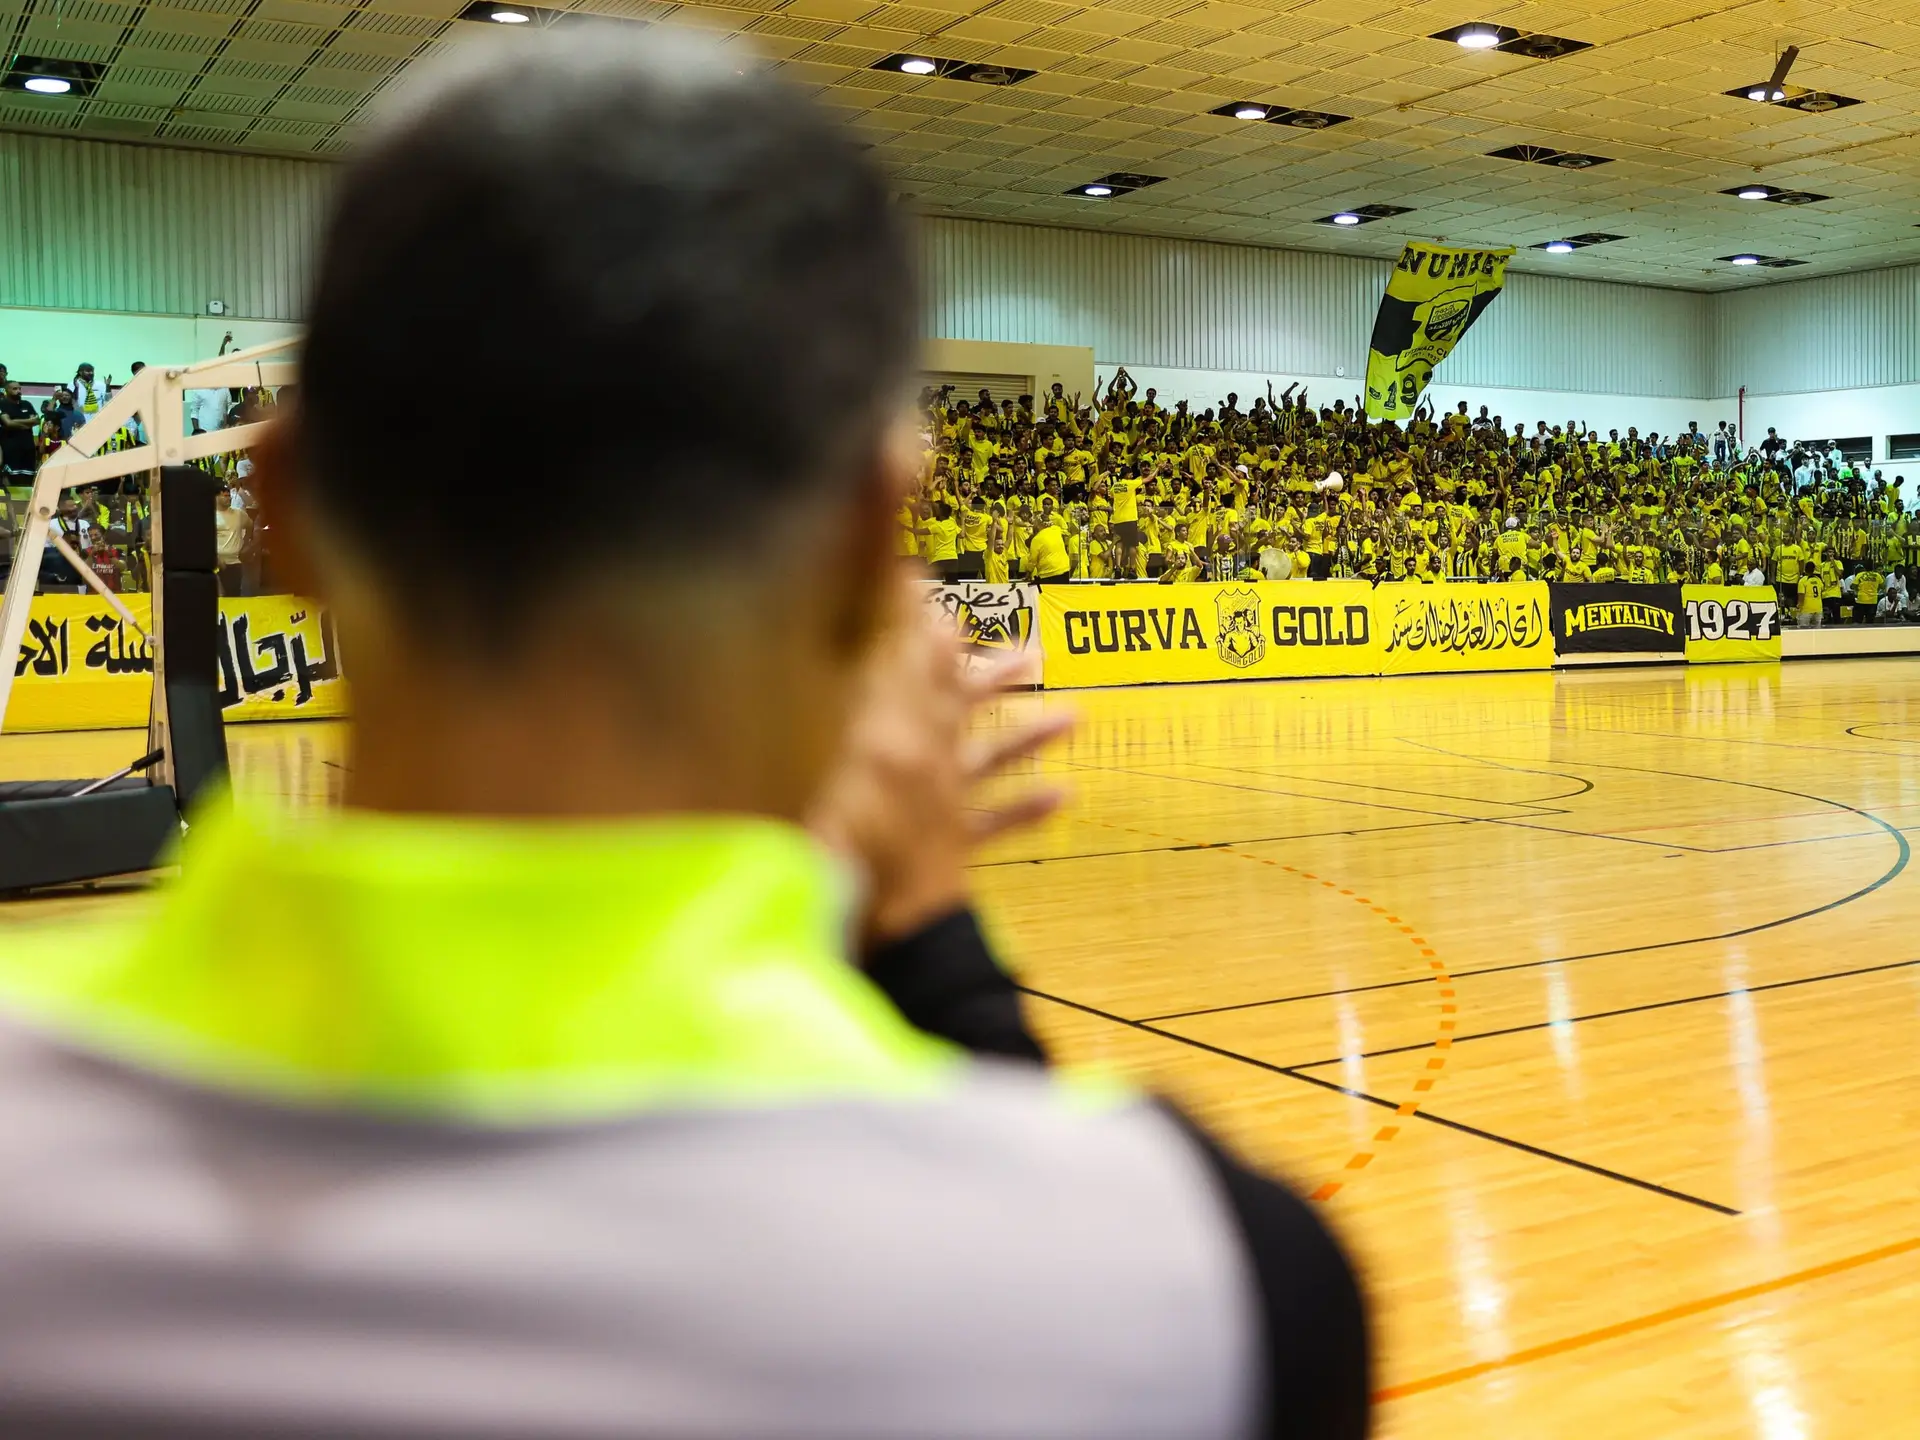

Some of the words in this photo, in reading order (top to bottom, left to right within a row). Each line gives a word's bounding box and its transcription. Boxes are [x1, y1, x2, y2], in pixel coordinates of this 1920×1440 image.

[1064, 607, 1207, 655] CURVA
[1272, 605, 1370, 646] GOLD
[1564, 603, 1675, 638] MENTALITY
[1686, 600, 1777, 641] 1927
